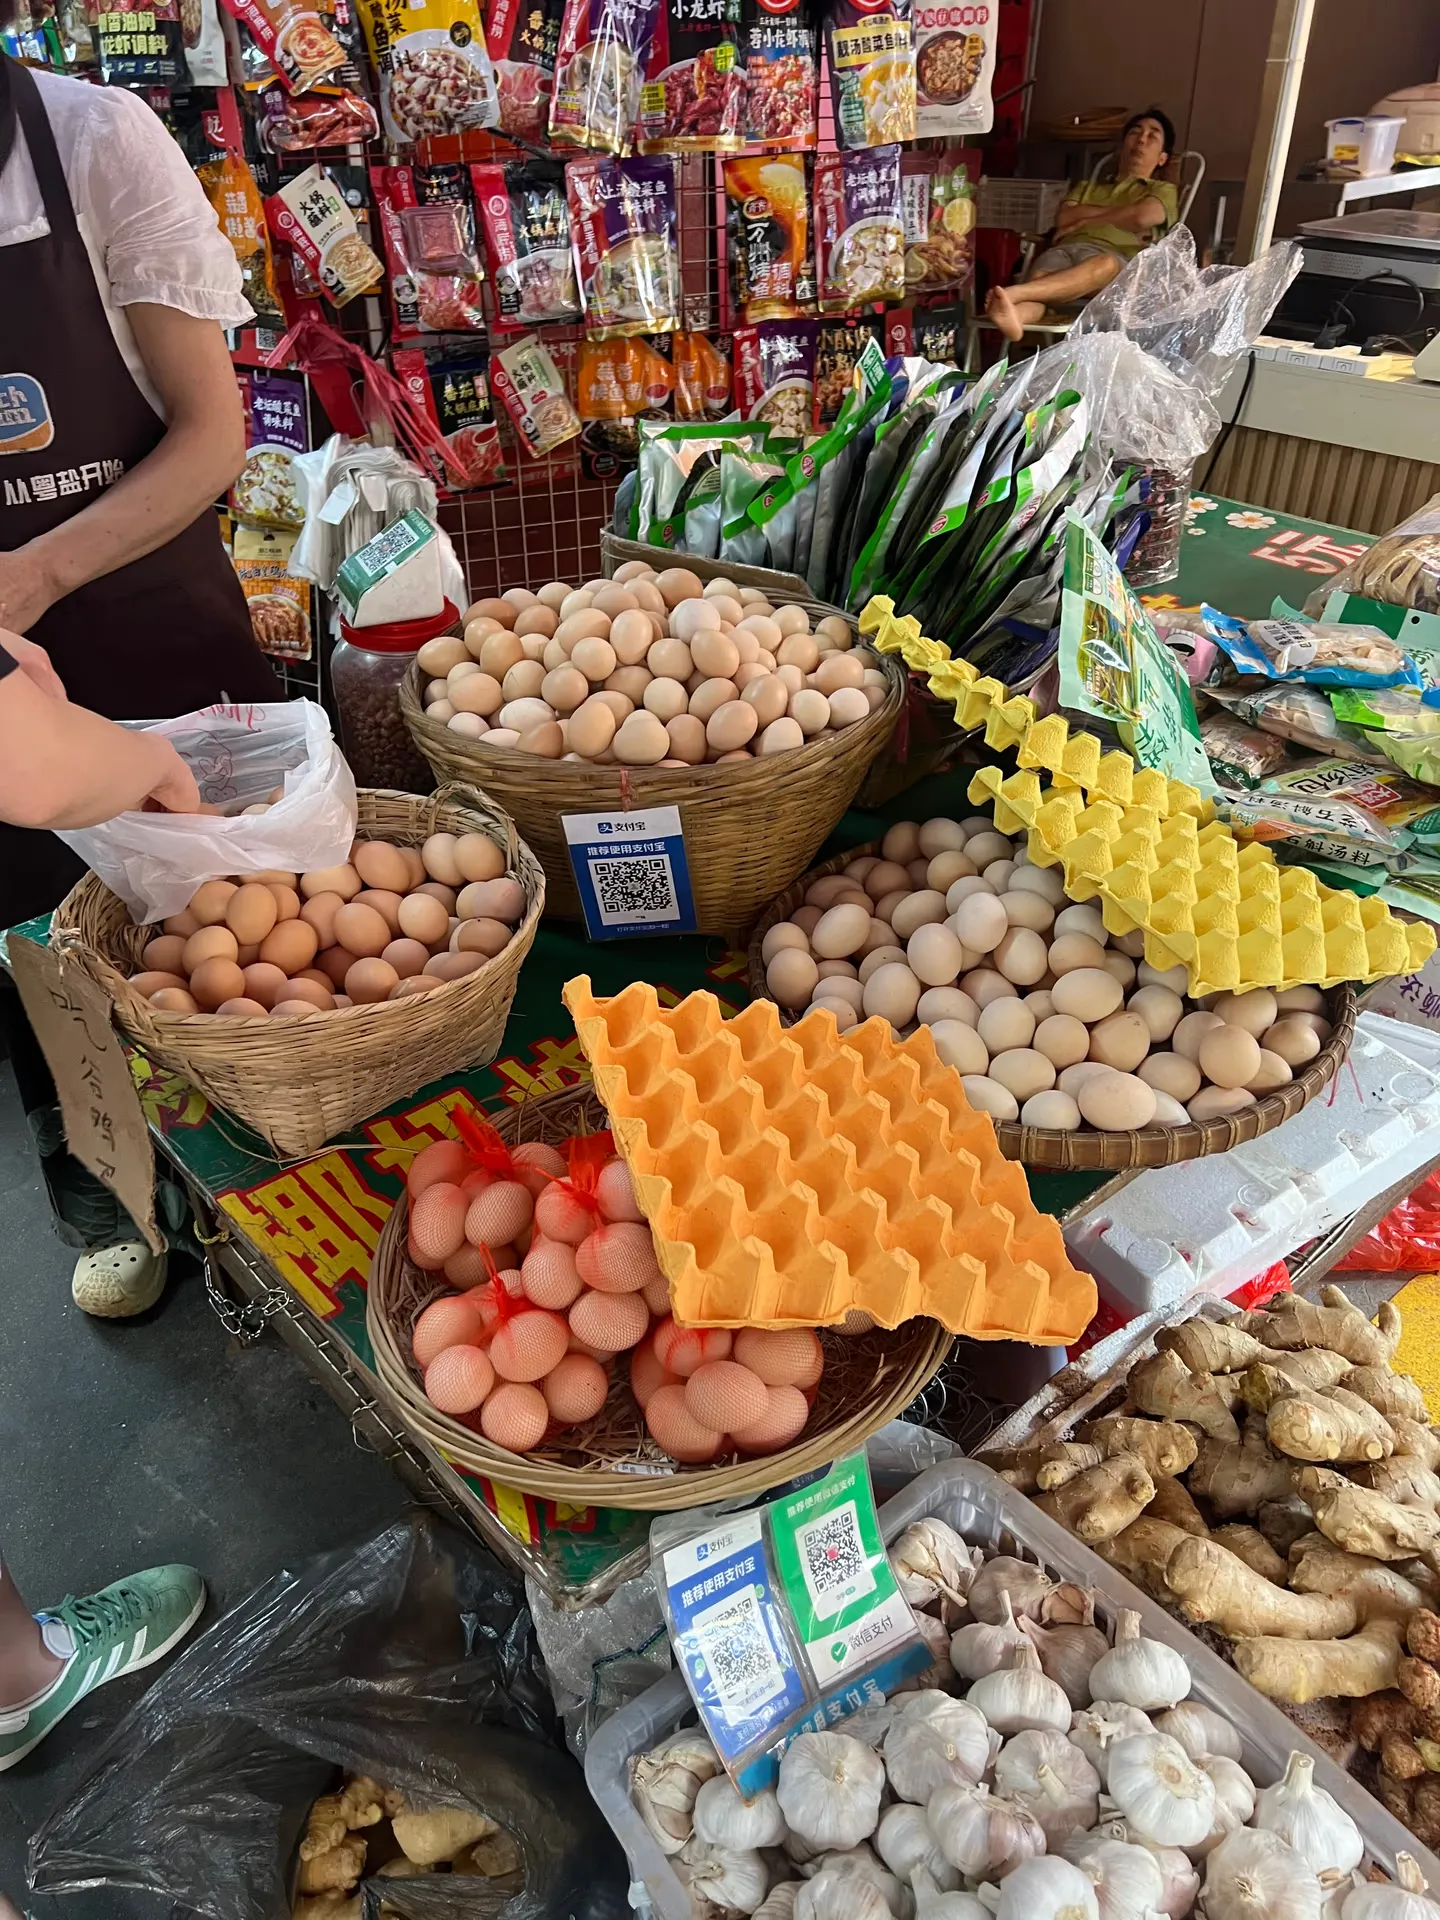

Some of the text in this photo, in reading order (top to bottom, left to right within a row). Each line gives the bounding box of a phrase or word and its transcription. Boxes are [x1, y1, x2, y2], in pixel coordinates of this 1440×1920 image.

[4, 459, 124, 505] 从粤盐开始
[614, 821, 646, 833] 支付宝
[587, 841, 666, 857] 推荐使用支付宝
[786, 1474, 855, 1518] 推荐使用微信支付
[709, 1533, 734, 1555] 支付宝
[681, 1556, 756, 1609] 推荐使用支付宝
[848, 1615, 893, 1651] 微信支付
